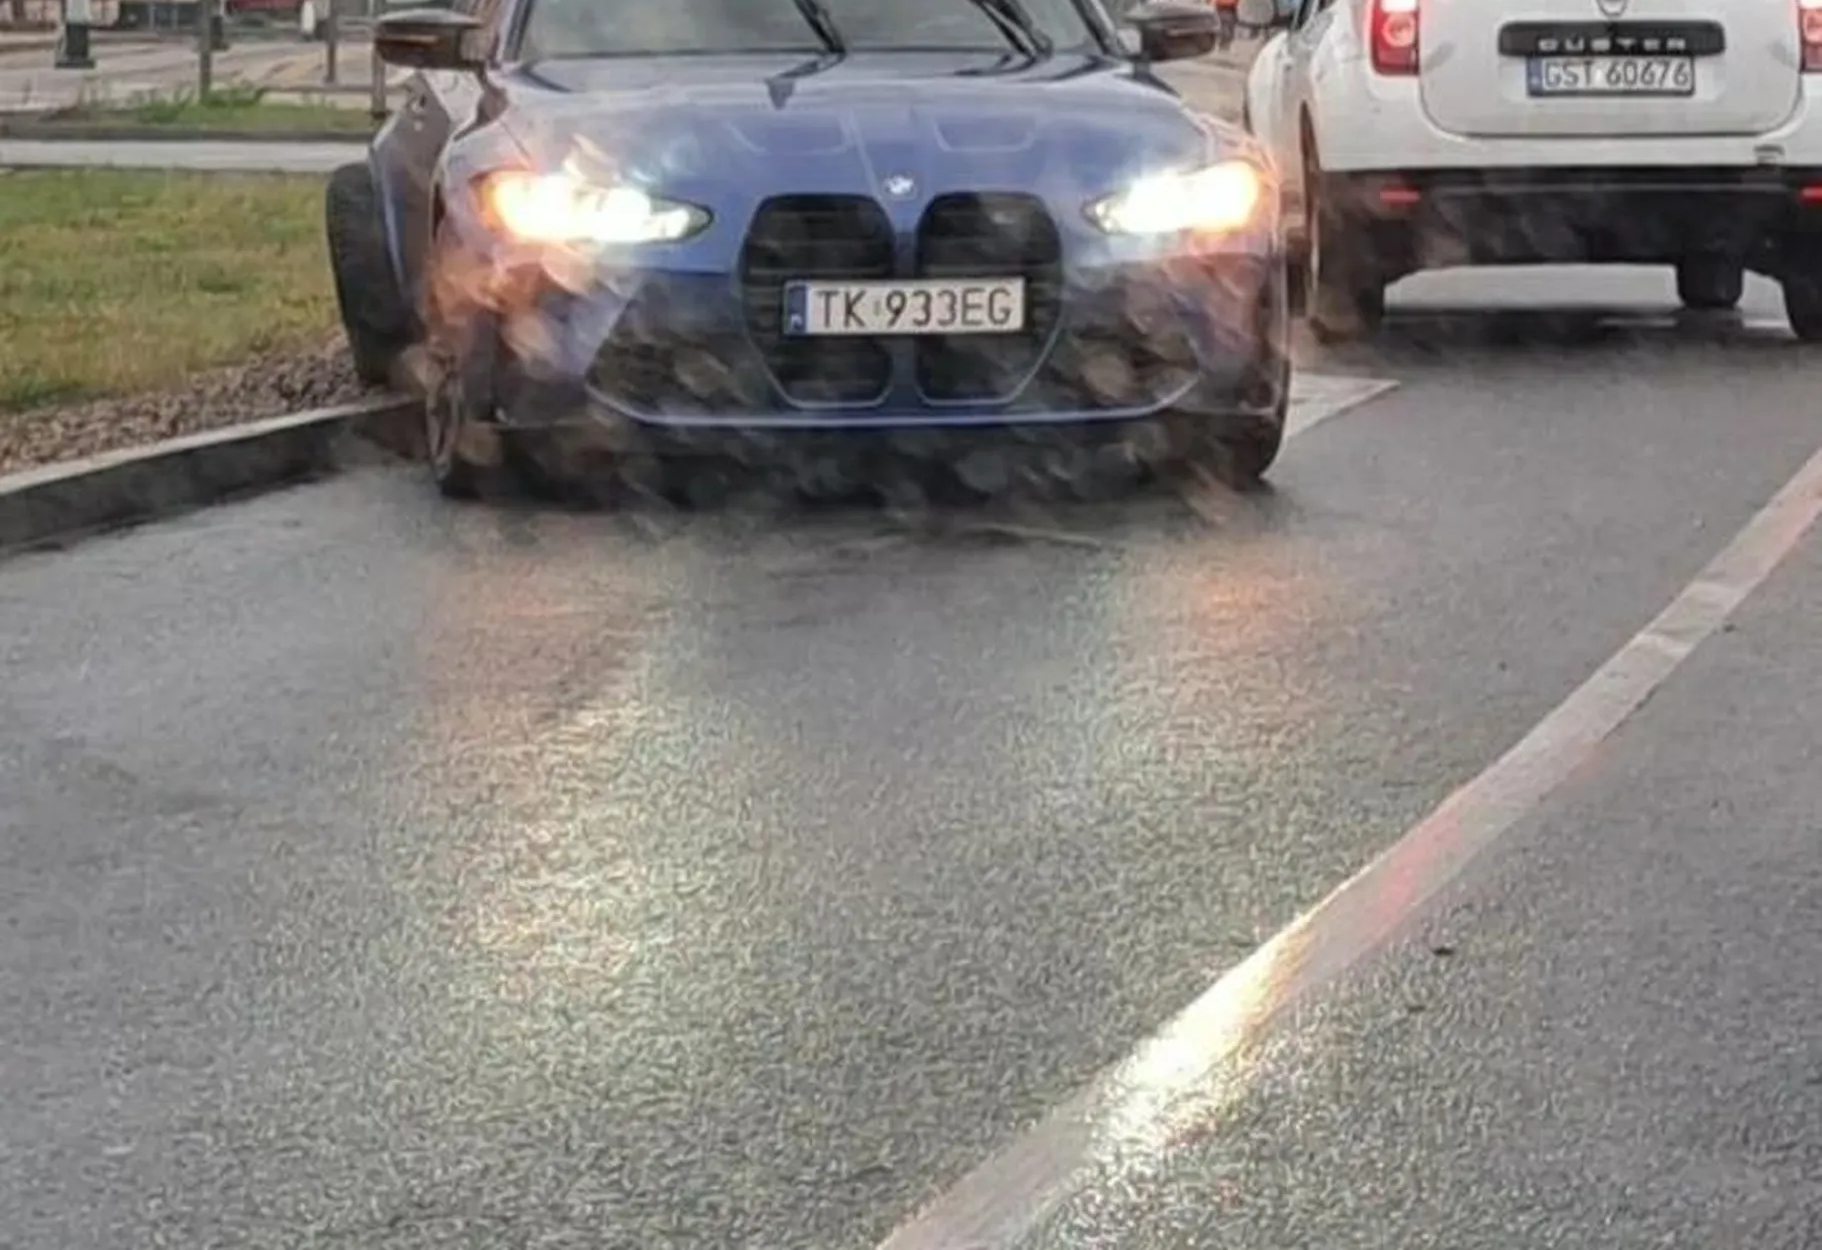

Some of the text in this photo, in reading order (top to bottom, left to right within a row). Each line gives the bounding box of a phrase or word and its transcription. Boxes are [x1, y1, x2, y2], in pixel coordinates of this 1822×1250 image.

[1538, 37, 1687, 52] DUSTER
[1544, 59, 1596, 87] GST
[1605, 59, 1690, 88] 60676
[815, 289, 867, 329] TK
[885, 287, 1012, 327] 933EG
